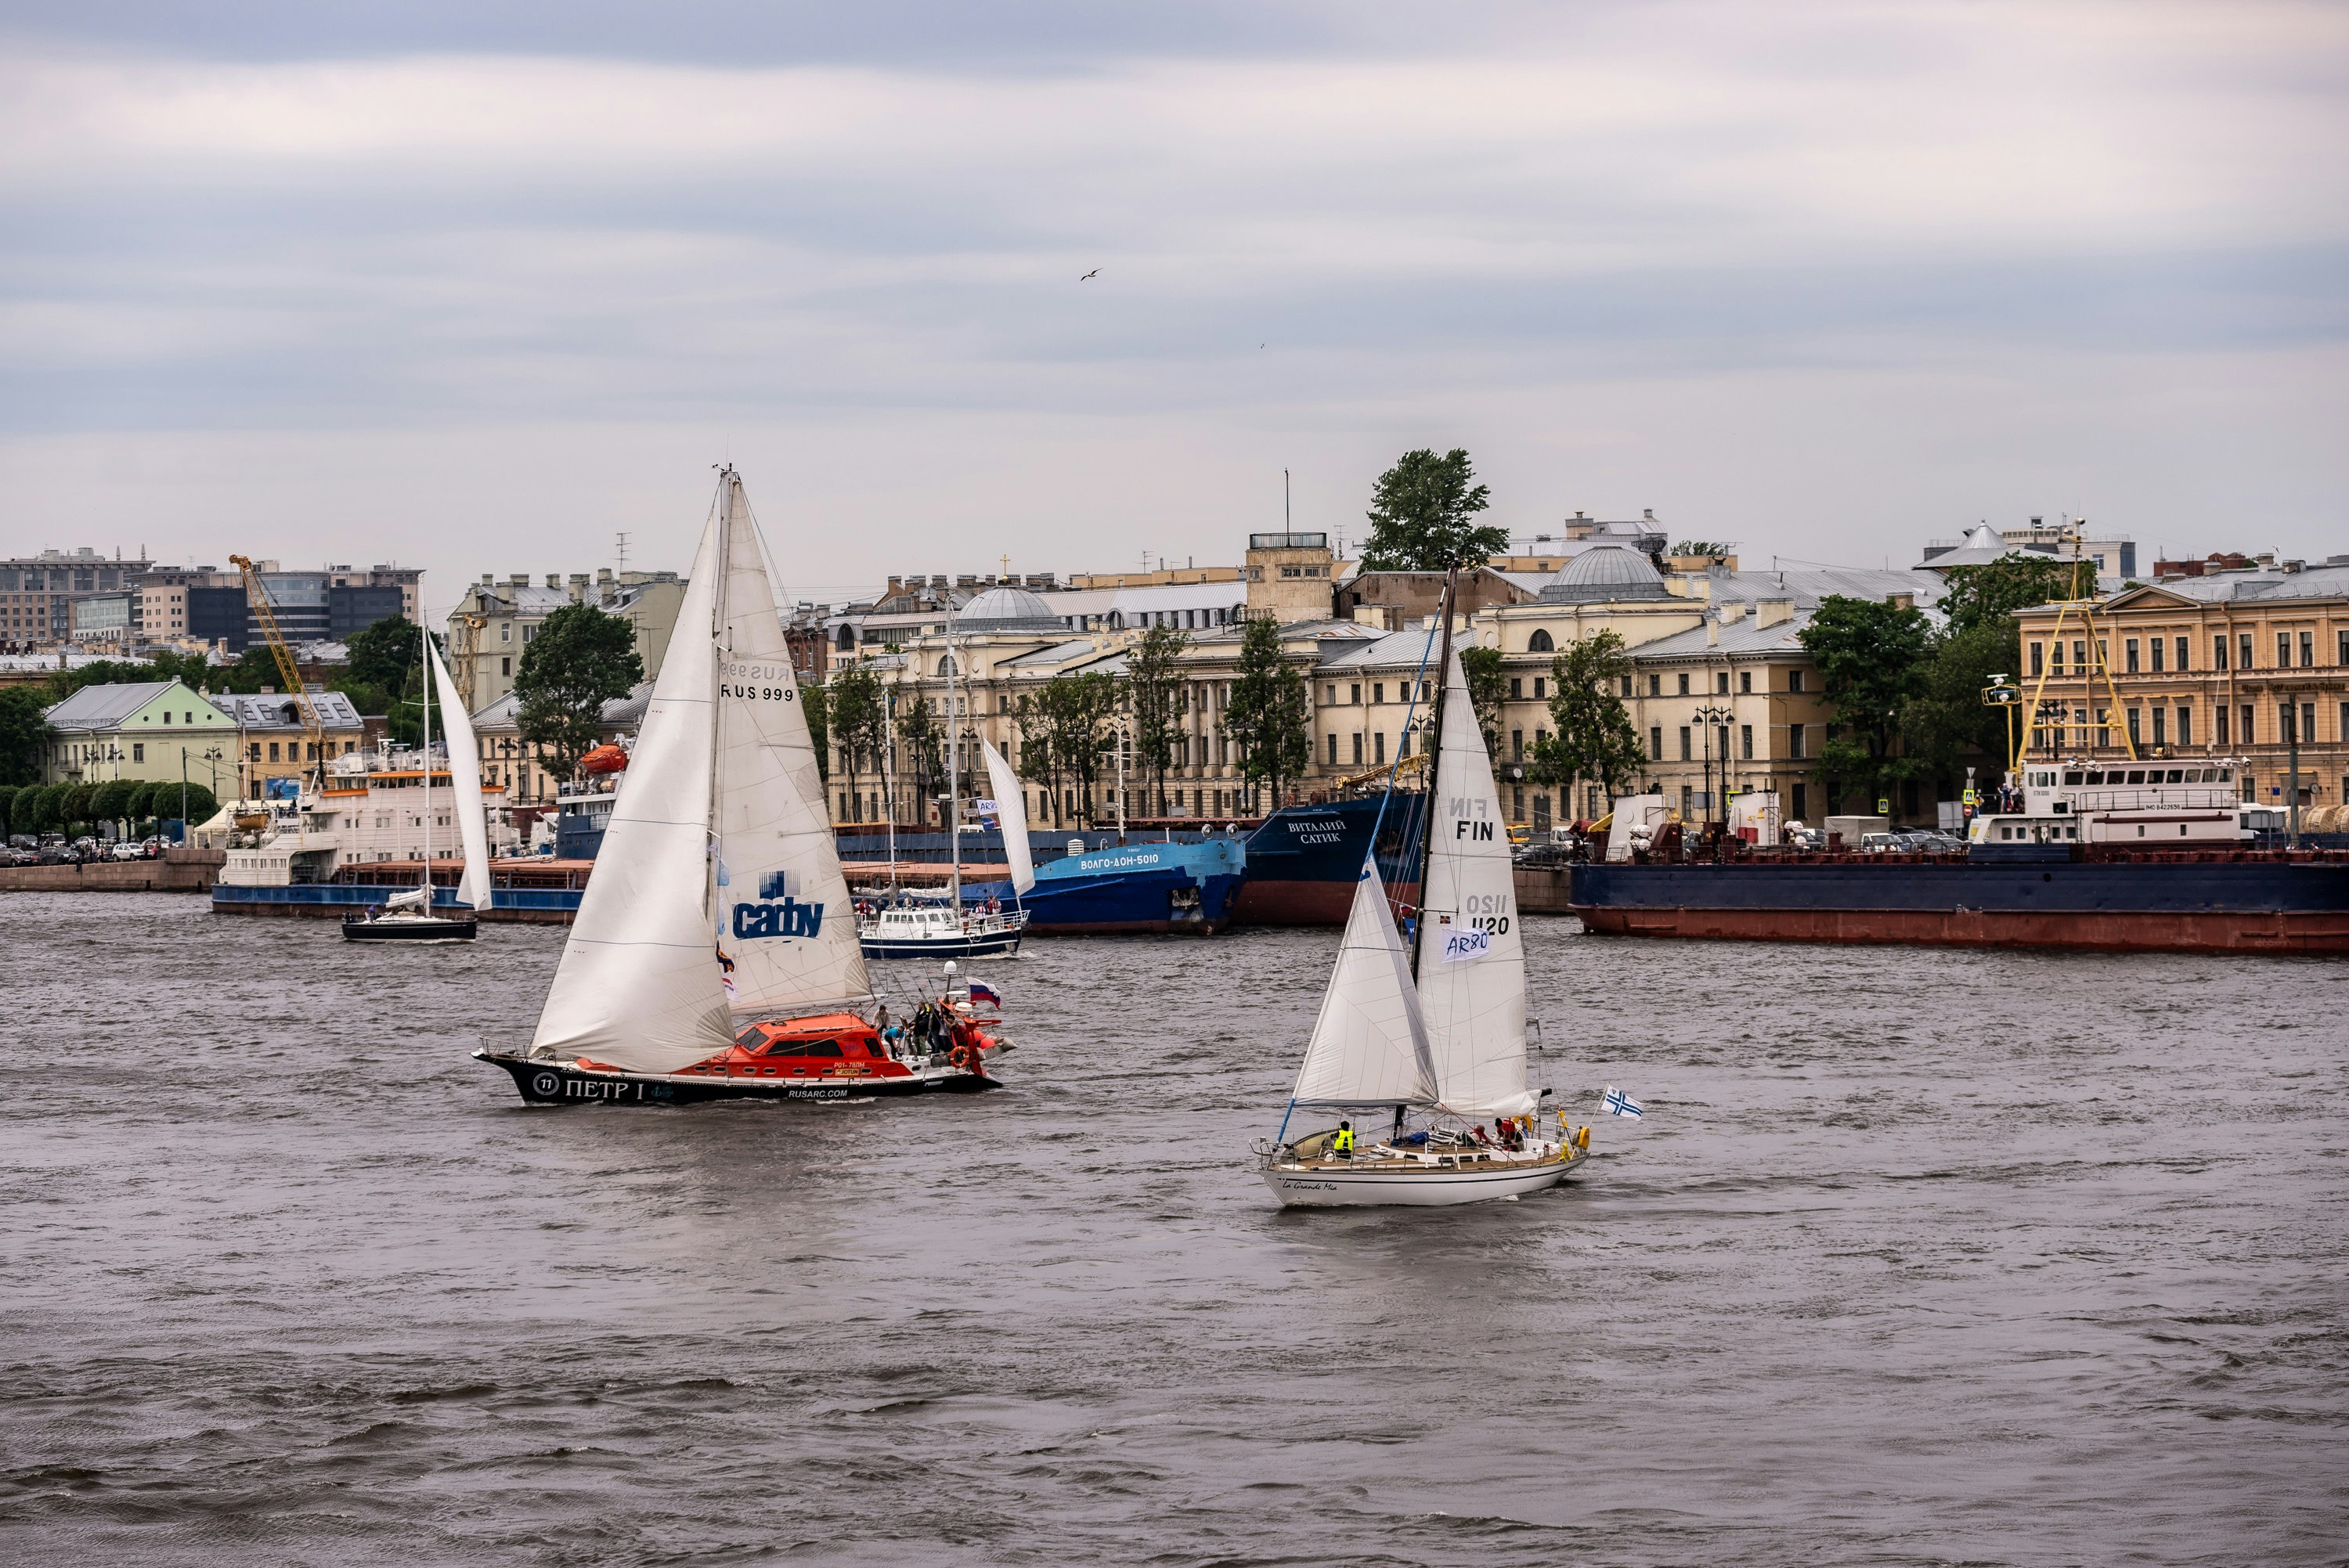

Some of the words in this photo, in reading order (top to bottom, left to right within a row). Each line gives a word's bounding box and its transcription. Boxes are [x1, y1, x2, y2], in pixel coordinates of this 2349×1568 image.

[720, 684, 756, 699] RUS
[763, 688, 793, 701] 999
[1287, 820, 1347, 832] ВИТАЛИЙ
[1456, 820, 1493, 841] FIN
[1300, 833, 1341, 844] САТИК
[1081, 854, 1159, 870] ВОЛГО-ДОН-5010
[1472, 917, 1510, 935] 1120
[1446, 932, 1488, 955] AR80
[540, 1079, 551, 1089] 11
[566, 1080, 629, 1099] ПЕТР
[637, 1083, 644, 1100] I
[788, 1090, 848, 1098] RUSARC.COM
[1294, 1181, 1322, 1190] Grande
